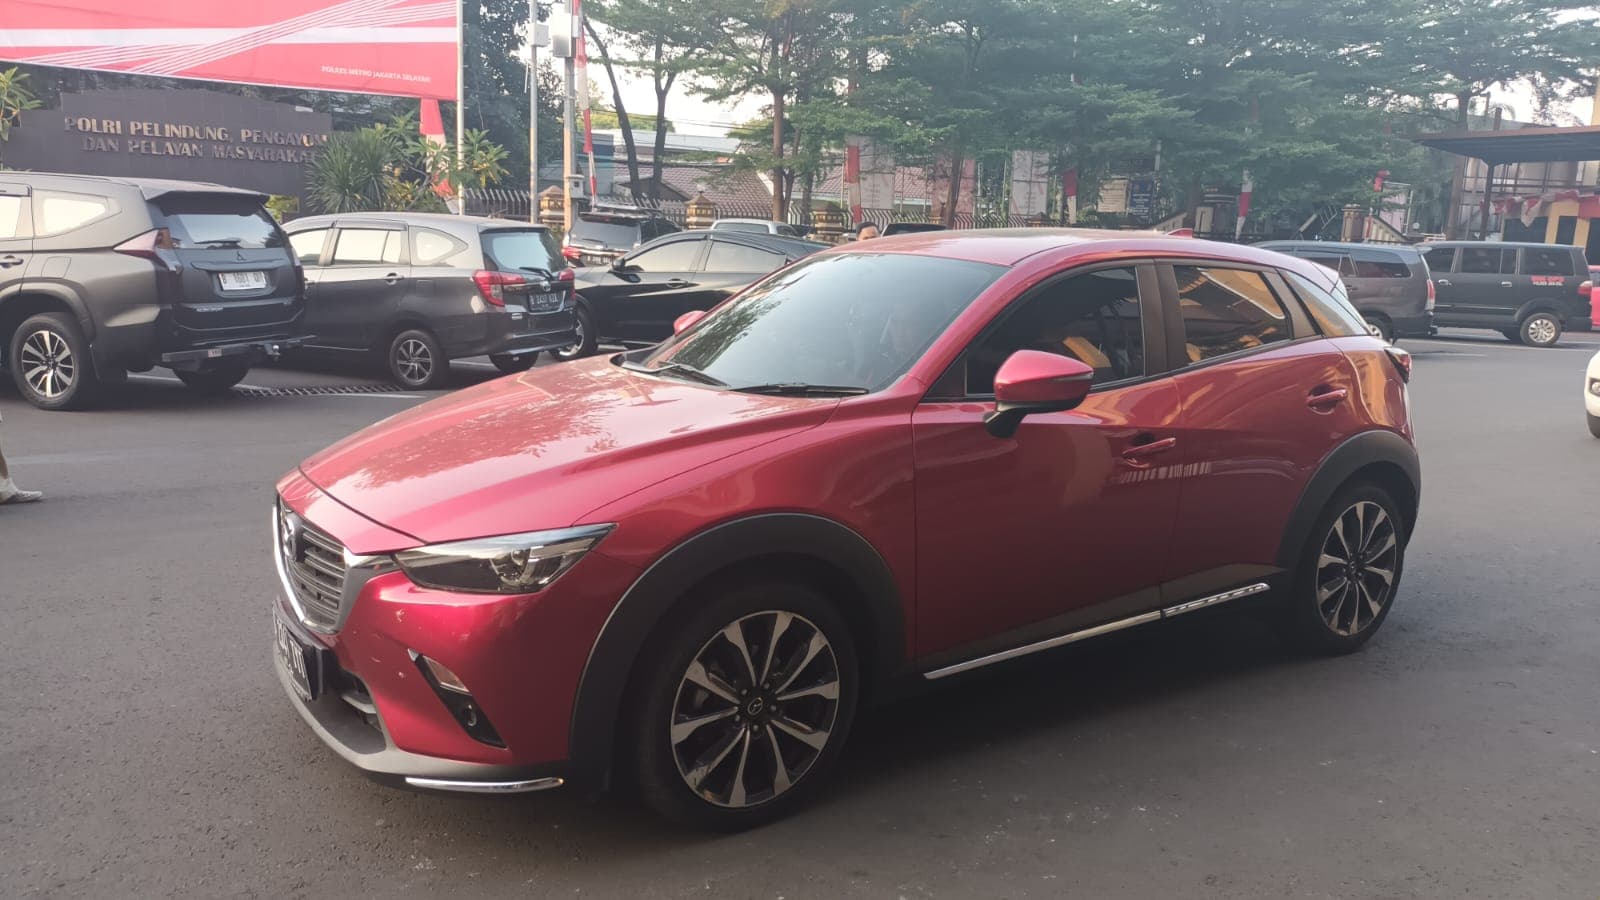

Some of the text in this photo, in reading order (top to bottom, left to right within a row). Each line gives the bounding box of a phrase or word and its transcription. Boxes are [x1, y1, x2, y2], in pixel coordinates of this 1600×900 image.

[373, 71, 401, 80] JAKARTA
[402, 74, 431, 82] SELATAN
[64, 117, 122, 134] POLRI
[130, 121, 233, 143] PELINDUNG,
[82, 137, 120, 152] DAN
[128, 140, 203, 157] PELAYAN
